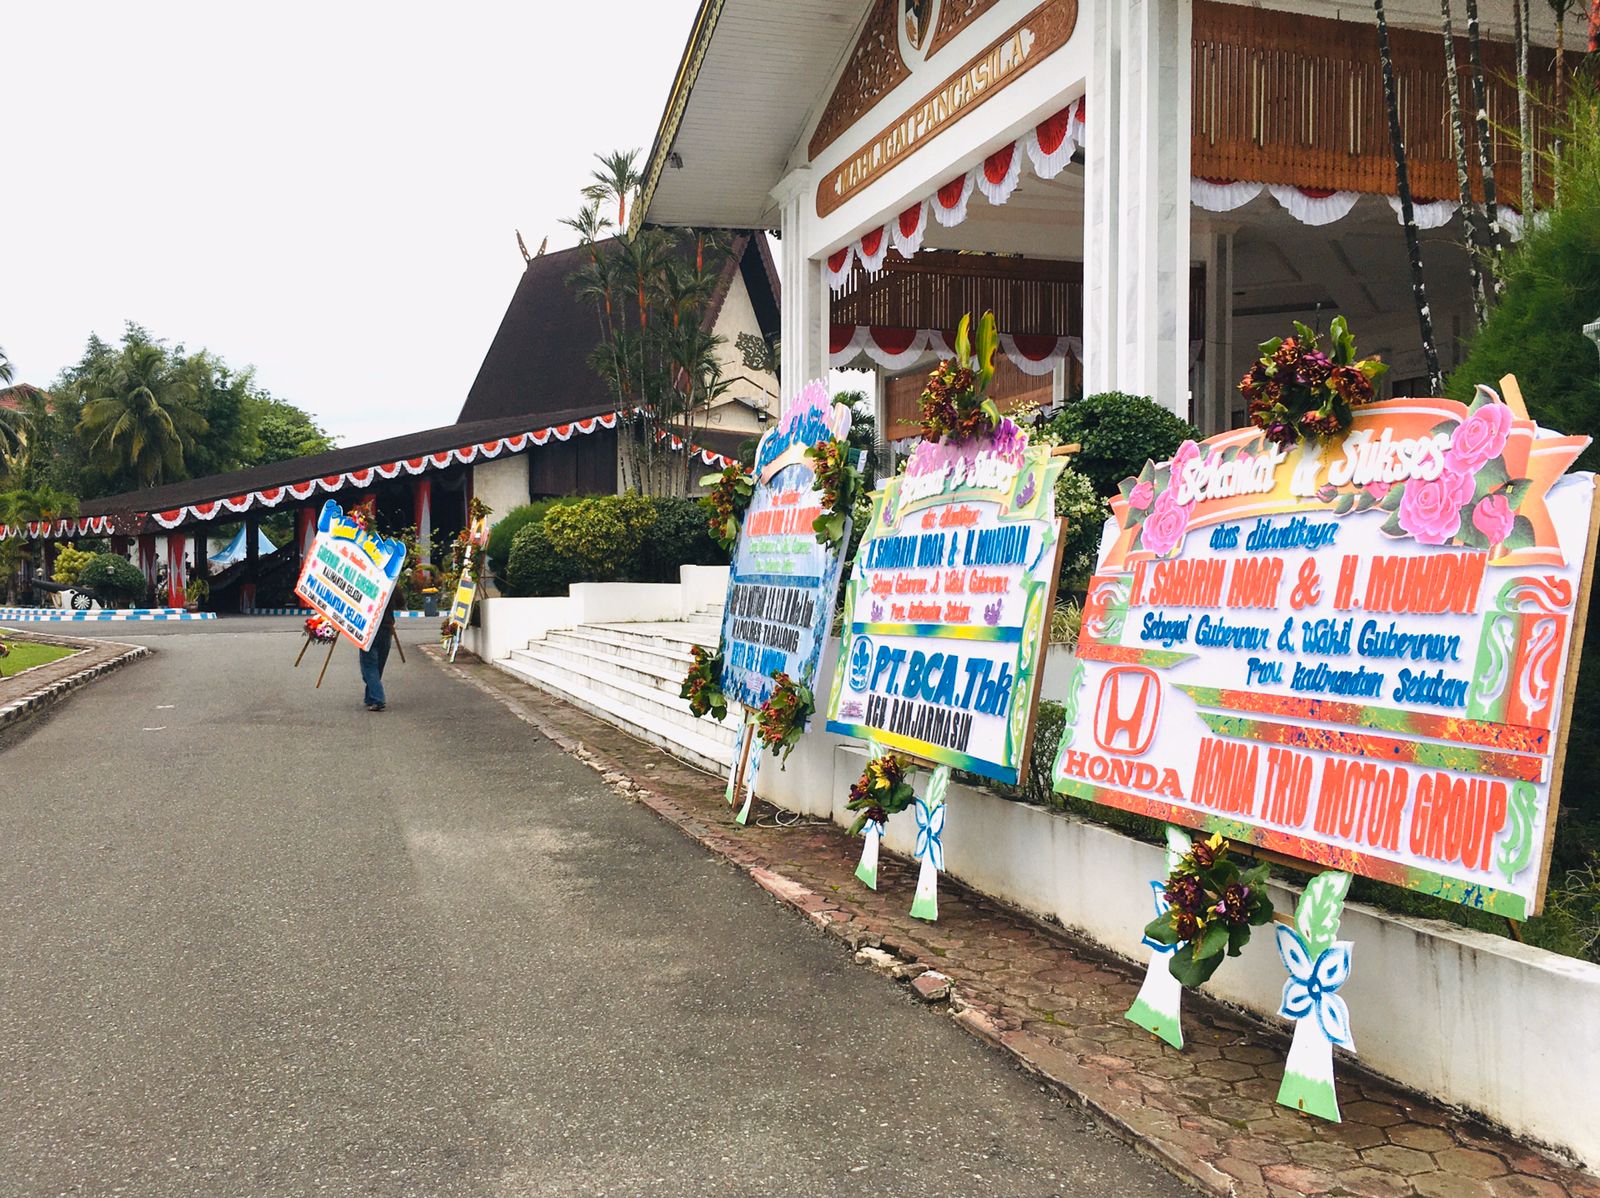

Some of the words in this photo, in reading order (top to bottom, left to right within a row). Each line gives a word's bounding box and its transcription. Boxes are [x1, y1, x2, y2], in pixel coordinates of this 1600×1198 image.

[838, 116, 911, 196] MAHLIGAI
[911, 30, 1025, 143] PANCASILA
[1177, 441, 1287, 505] Selamat
[1328, 427, 1451, 486] Sukses
[918, 533, 945, 567] NOOR
[1209, 523, 1240, 549] atas
[1246, 516, 1339, 551] dilantiknya
[1226, 557, 1284, 608] NOOR
[1290, 556, 1321, 609] &
[763, 624, 800, 653] TABALONG
[1140, 611, 1192, 648] Sebagai
[1195, 614, 1270, 650] Gubernur
[1277, 616, 1294, 652] &
[1301, 618, 1353, 655] Wakil
[1357, 619, 1460, 662] Gubernur
[1393, 668, 1469, 706] Selatan
[889, 699, 973, 752] BANJARMASIN
[1063, 748, 1184, 797] HONDA
[1190, 737, 1259, 815] HONDA
[1261, 748, 1313, 826] TRIO
[1313, 757, 1408, 851] MOTOR
[1410, 772, 1507, 871] GROUP
